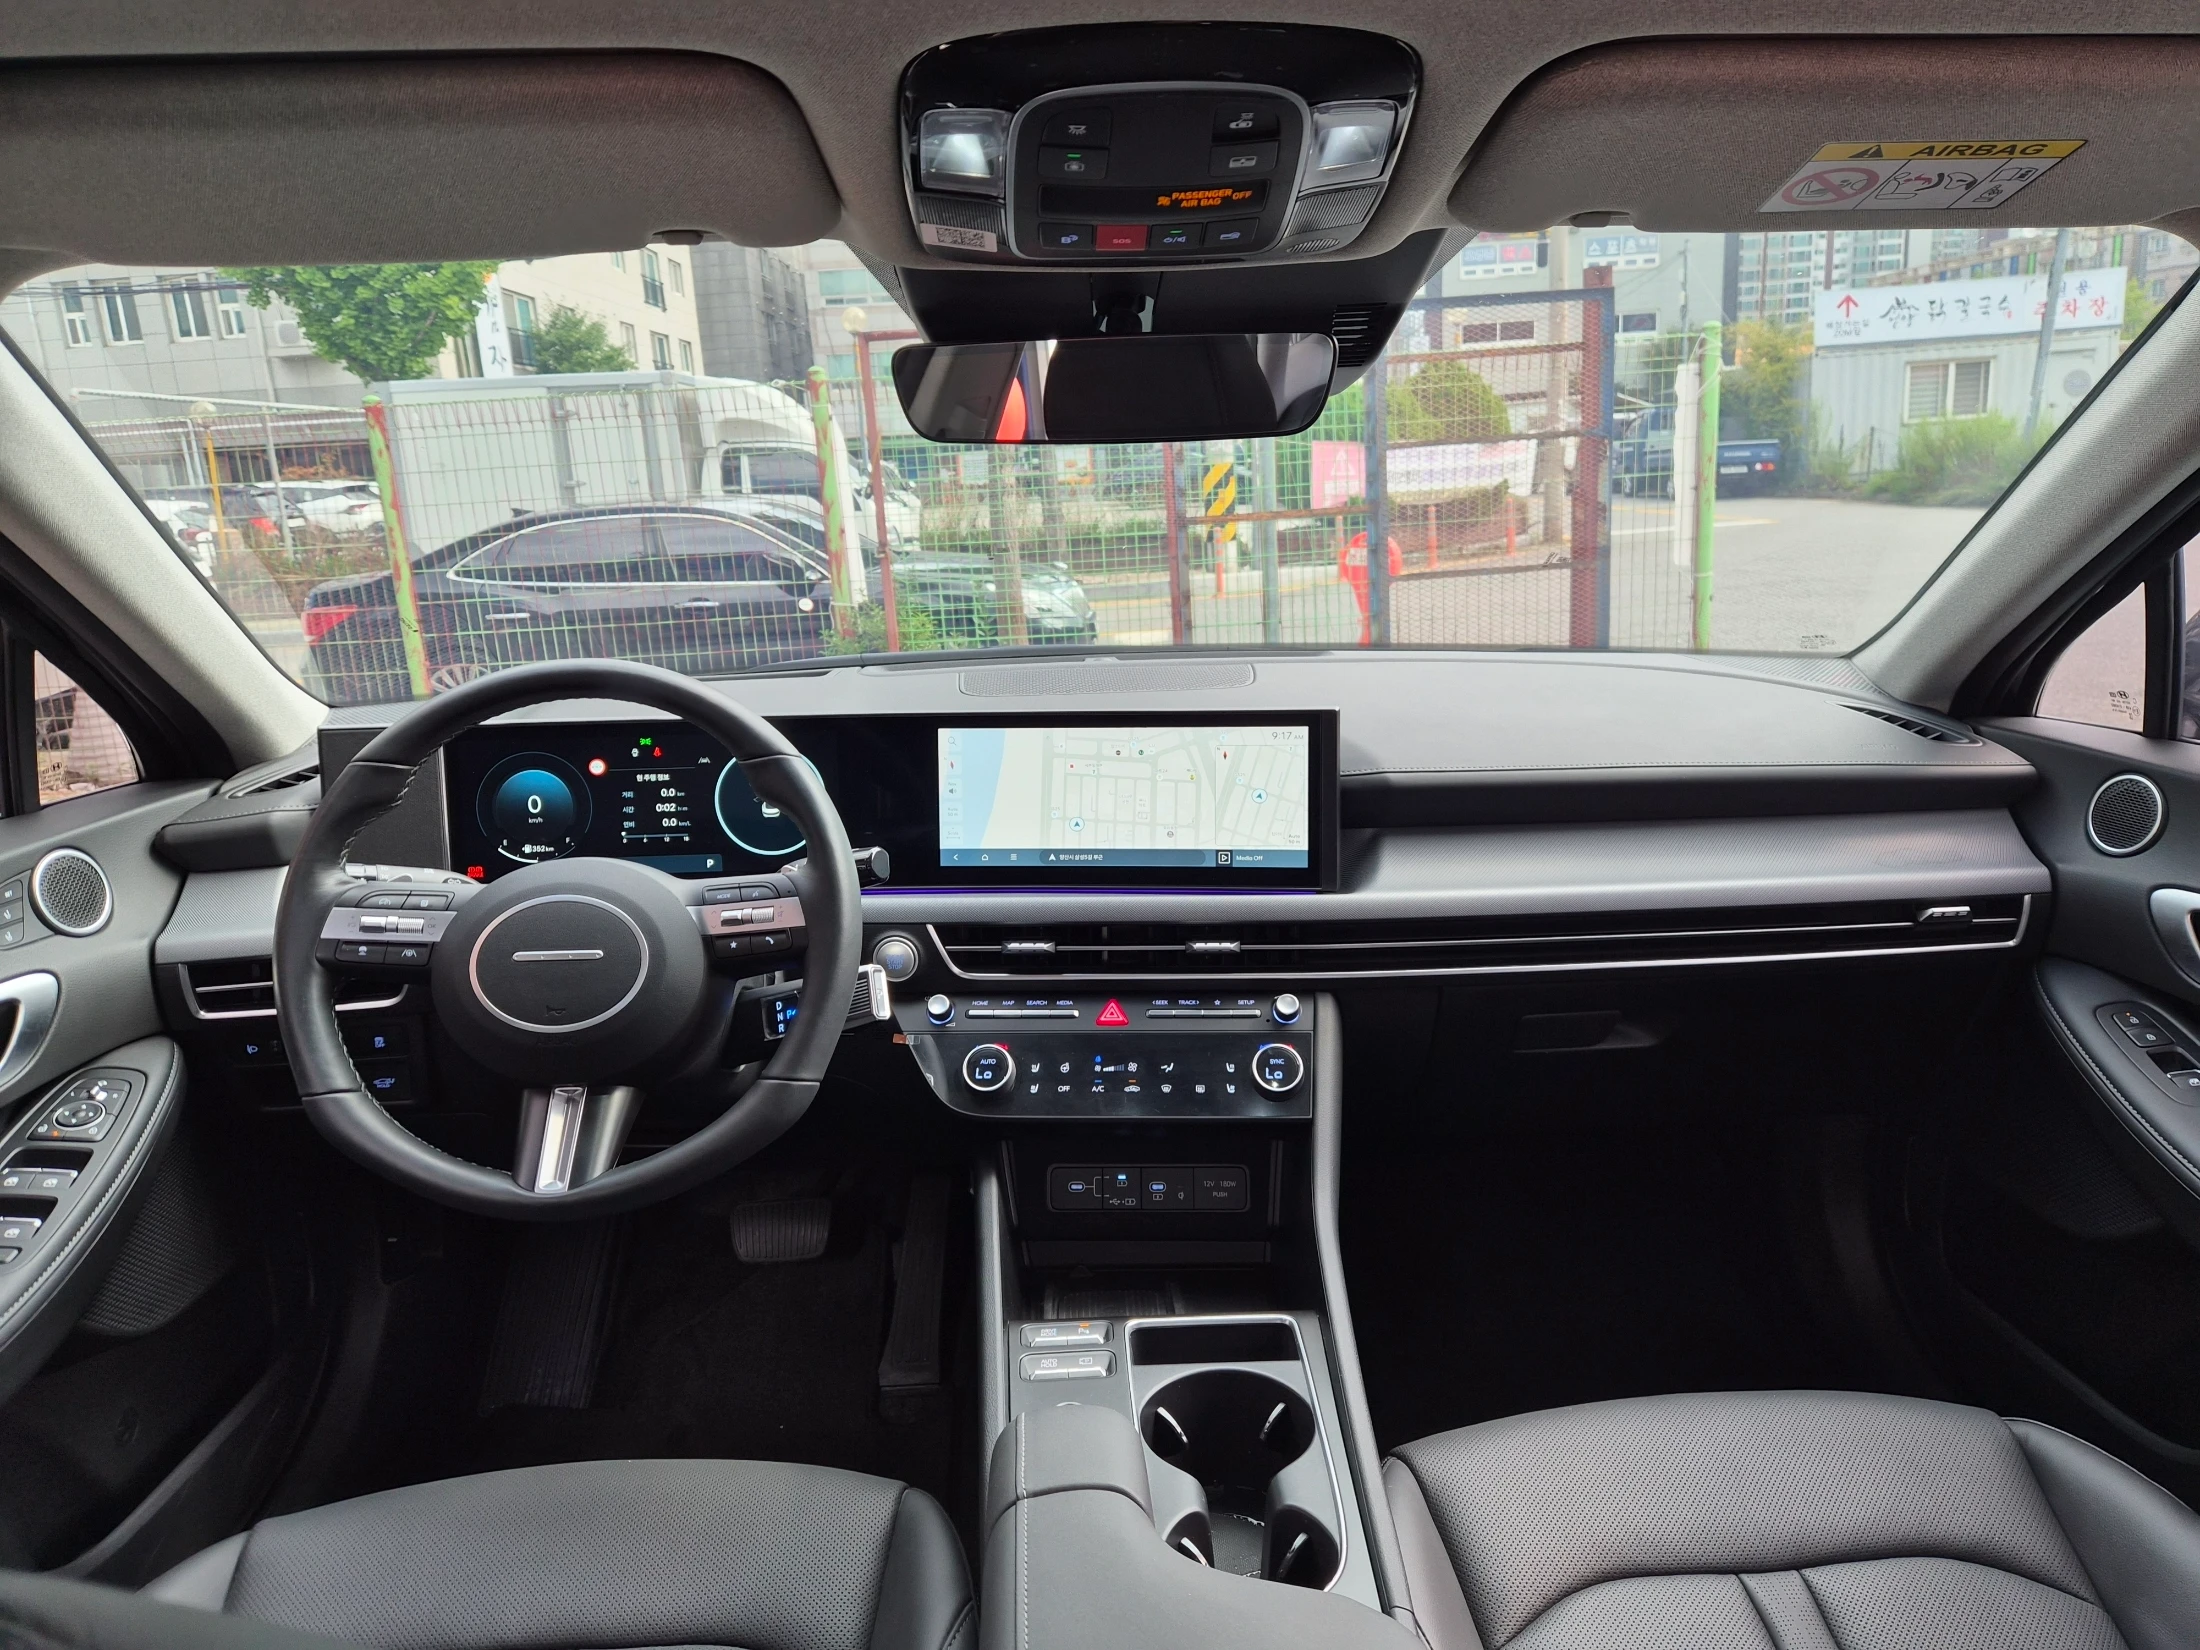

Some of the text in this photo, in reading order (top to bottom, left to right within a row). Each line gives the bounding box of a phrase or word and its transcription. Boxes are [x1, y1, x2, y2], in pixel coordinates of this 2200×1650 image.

[1909, 144, 2048, 156] AIRBAG
[1172, 189, 1252, 200] PASSENGER OFF
[1181, 198, 1221, 208] AIR BAG
[1271, 731, 1292, 740] 9:17
[622, 791, 634, 799] 거리
[660, 788, 676, 797] 0.0
[527, 795, 542, 814] 0
[655, 803, 676, 812] 0:02
[622, 806, 635, 814] 시간
[662, 818, 677, 827] 0.0
[707, 859, 714, 868] P
[776, 1001, 782, 1011] D
[777, 1012, 784, 1022] N
[786, 1009, 792, 1020] P
[778, 1023, 785, 1033] R
[975, 1068, 993, 1079] Lo
[1265, 1068, 1283, 1080] Lo
[1091, 1085, 1105, 1093] A/C
